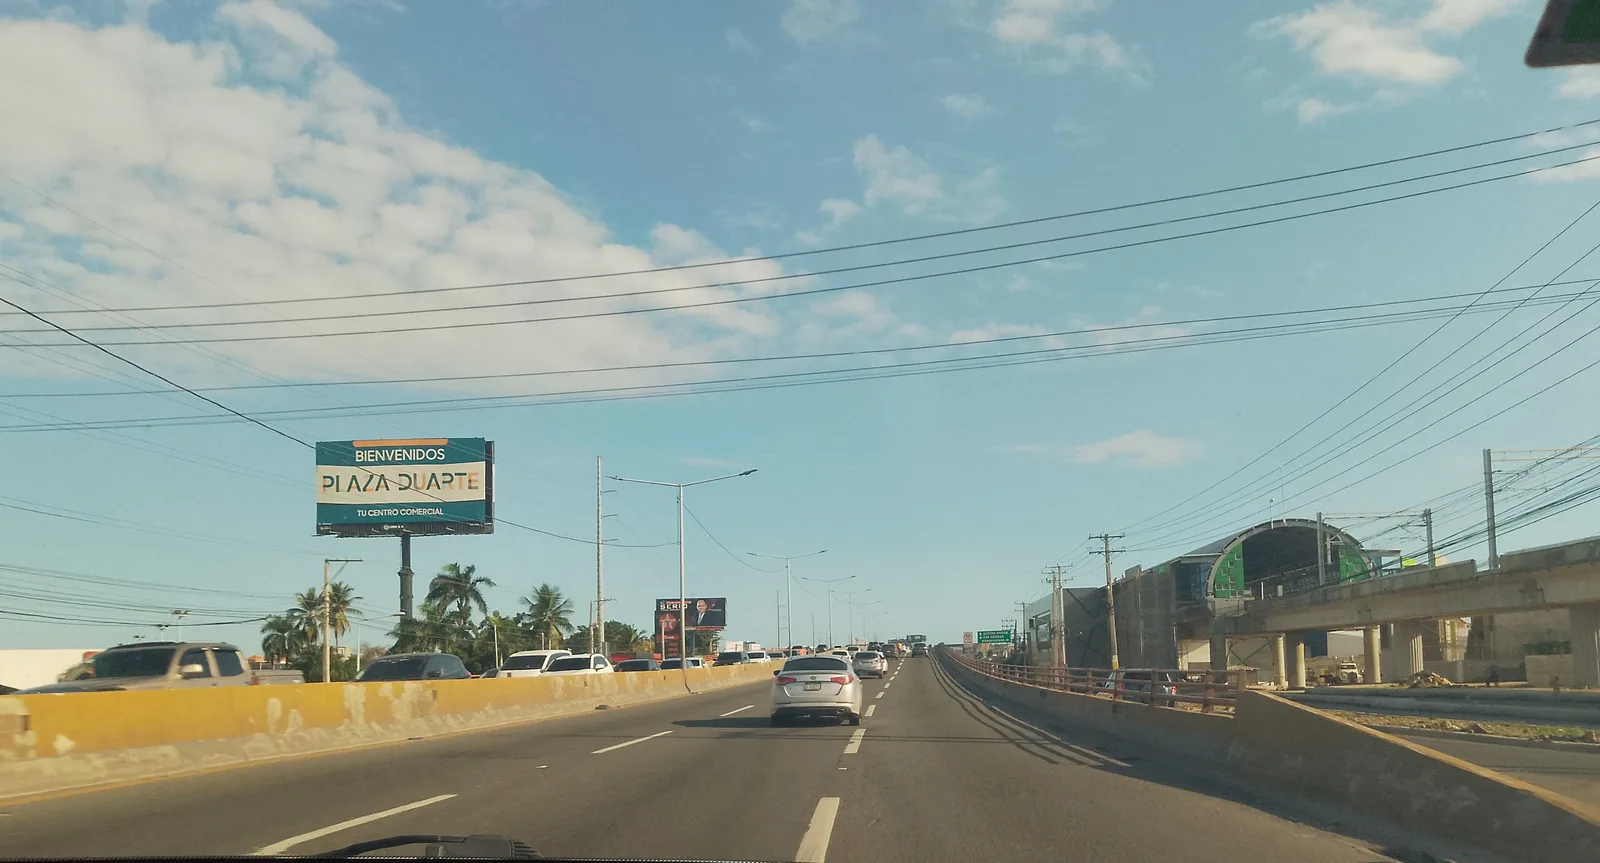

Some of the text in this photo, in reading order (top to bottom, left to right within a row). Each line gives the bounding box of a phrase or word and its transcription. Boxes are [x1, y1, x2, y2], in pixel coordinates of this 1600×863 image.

[355, 448, 445, 462] BIENVENIDOS
[322, 472, 479, 493] PLAZA DUARTE
[357, 507, 444, 517] TU CENTRO COMERCIAL
